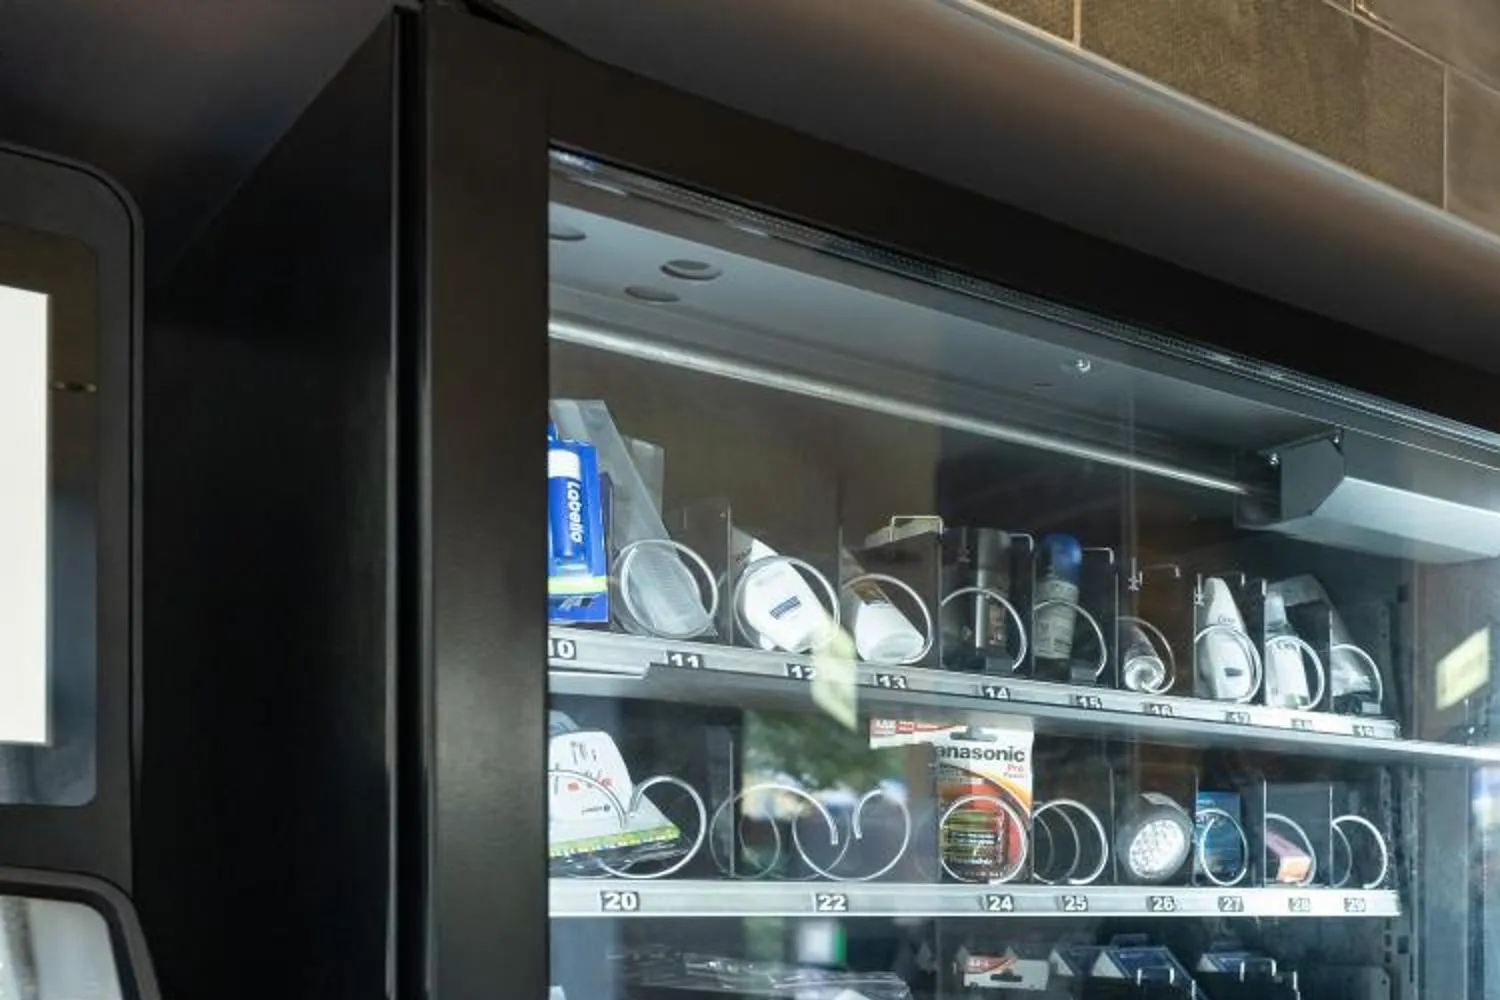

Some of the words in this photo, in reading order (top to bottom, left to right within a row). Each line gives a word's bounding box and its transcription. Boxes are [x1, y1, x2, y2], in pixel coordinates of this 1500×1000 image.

[671, 653, 700, 668] 11
[879, 675, 907, 689] 13
[984, 685, 1009, 700] 14
[936, 745, 1025, 763] anasonic
[603, 892, 637, 912] 20
[818, 895, 847, 912] 22
[988, 895, 1013, 912] 24
[1064, 896, 1087, 912] 25
[1151, 897, 1173, 912] 26
[1222, 897, 1241, 912] 27
